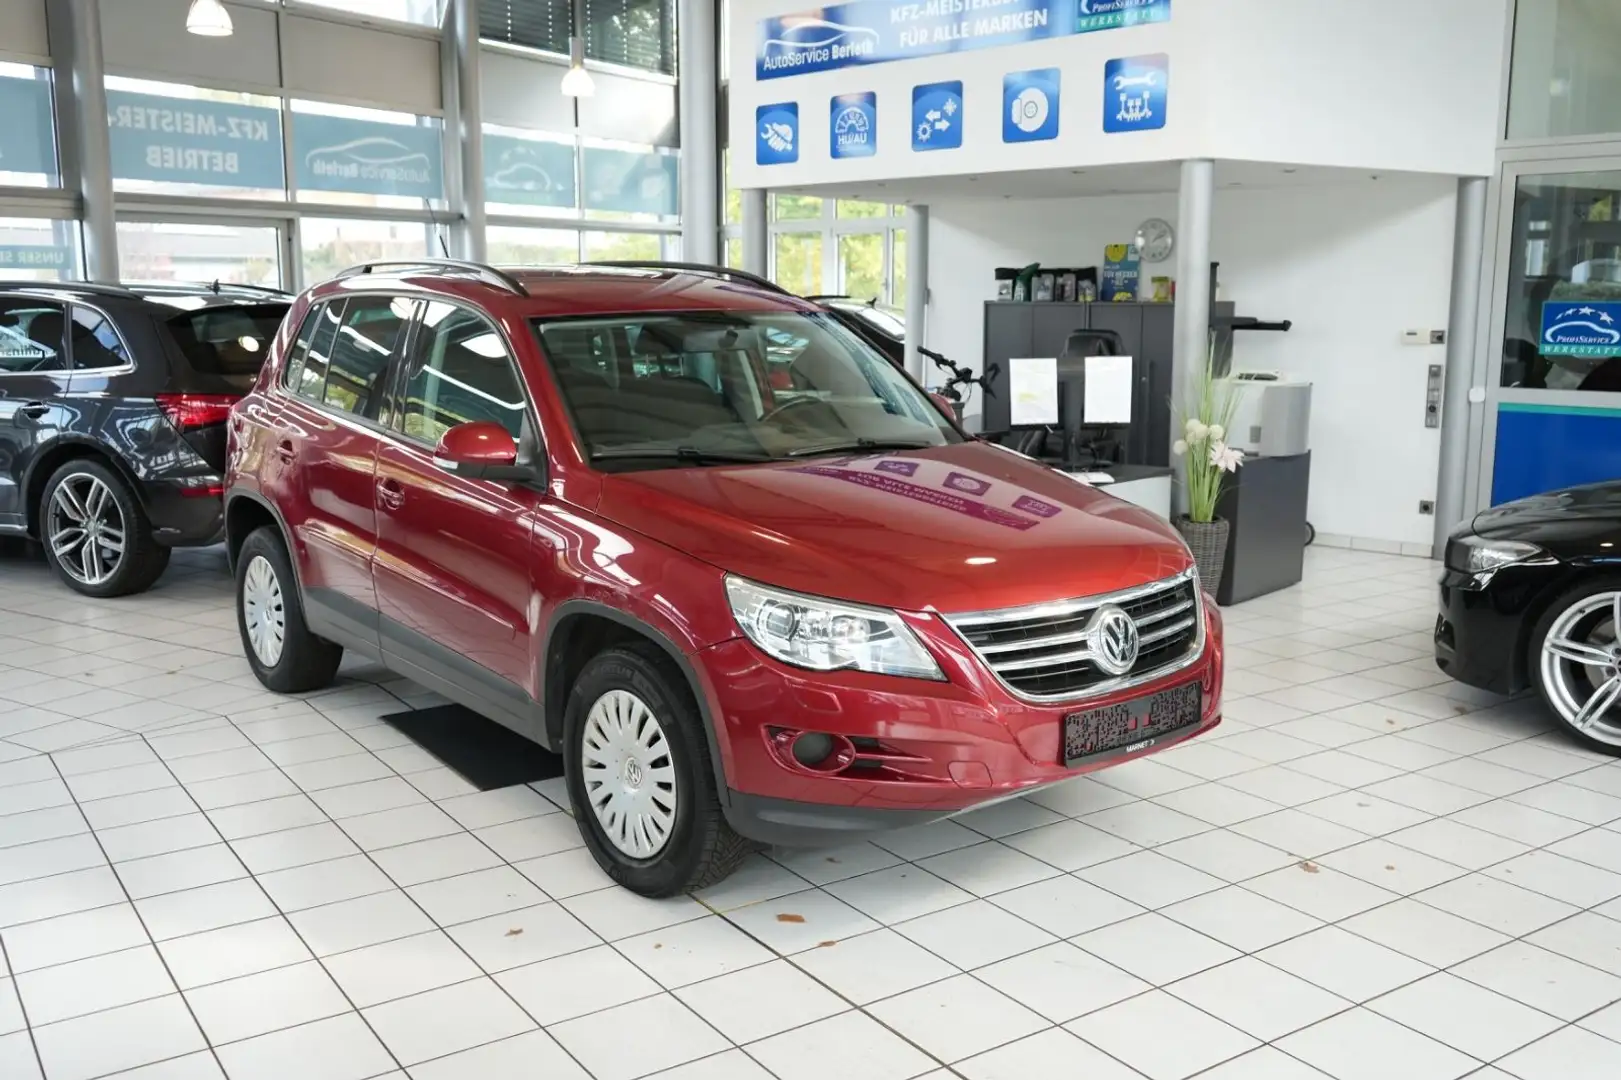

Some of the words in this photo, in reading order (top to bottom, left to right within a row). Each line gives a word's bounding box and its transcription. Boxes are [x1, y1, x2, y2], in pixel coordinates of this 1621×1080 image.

[890, 0, 1018, 24] KFZ-MEISTER
[900, 26, 928, 48] FÜR
[933, 22, 969, 42] ALLE
[974, 9, 1048, 36] MARKEN
[763, 47, 828, 71] AutoService
[1544, 344, 1619, 355] WERKSTATT
